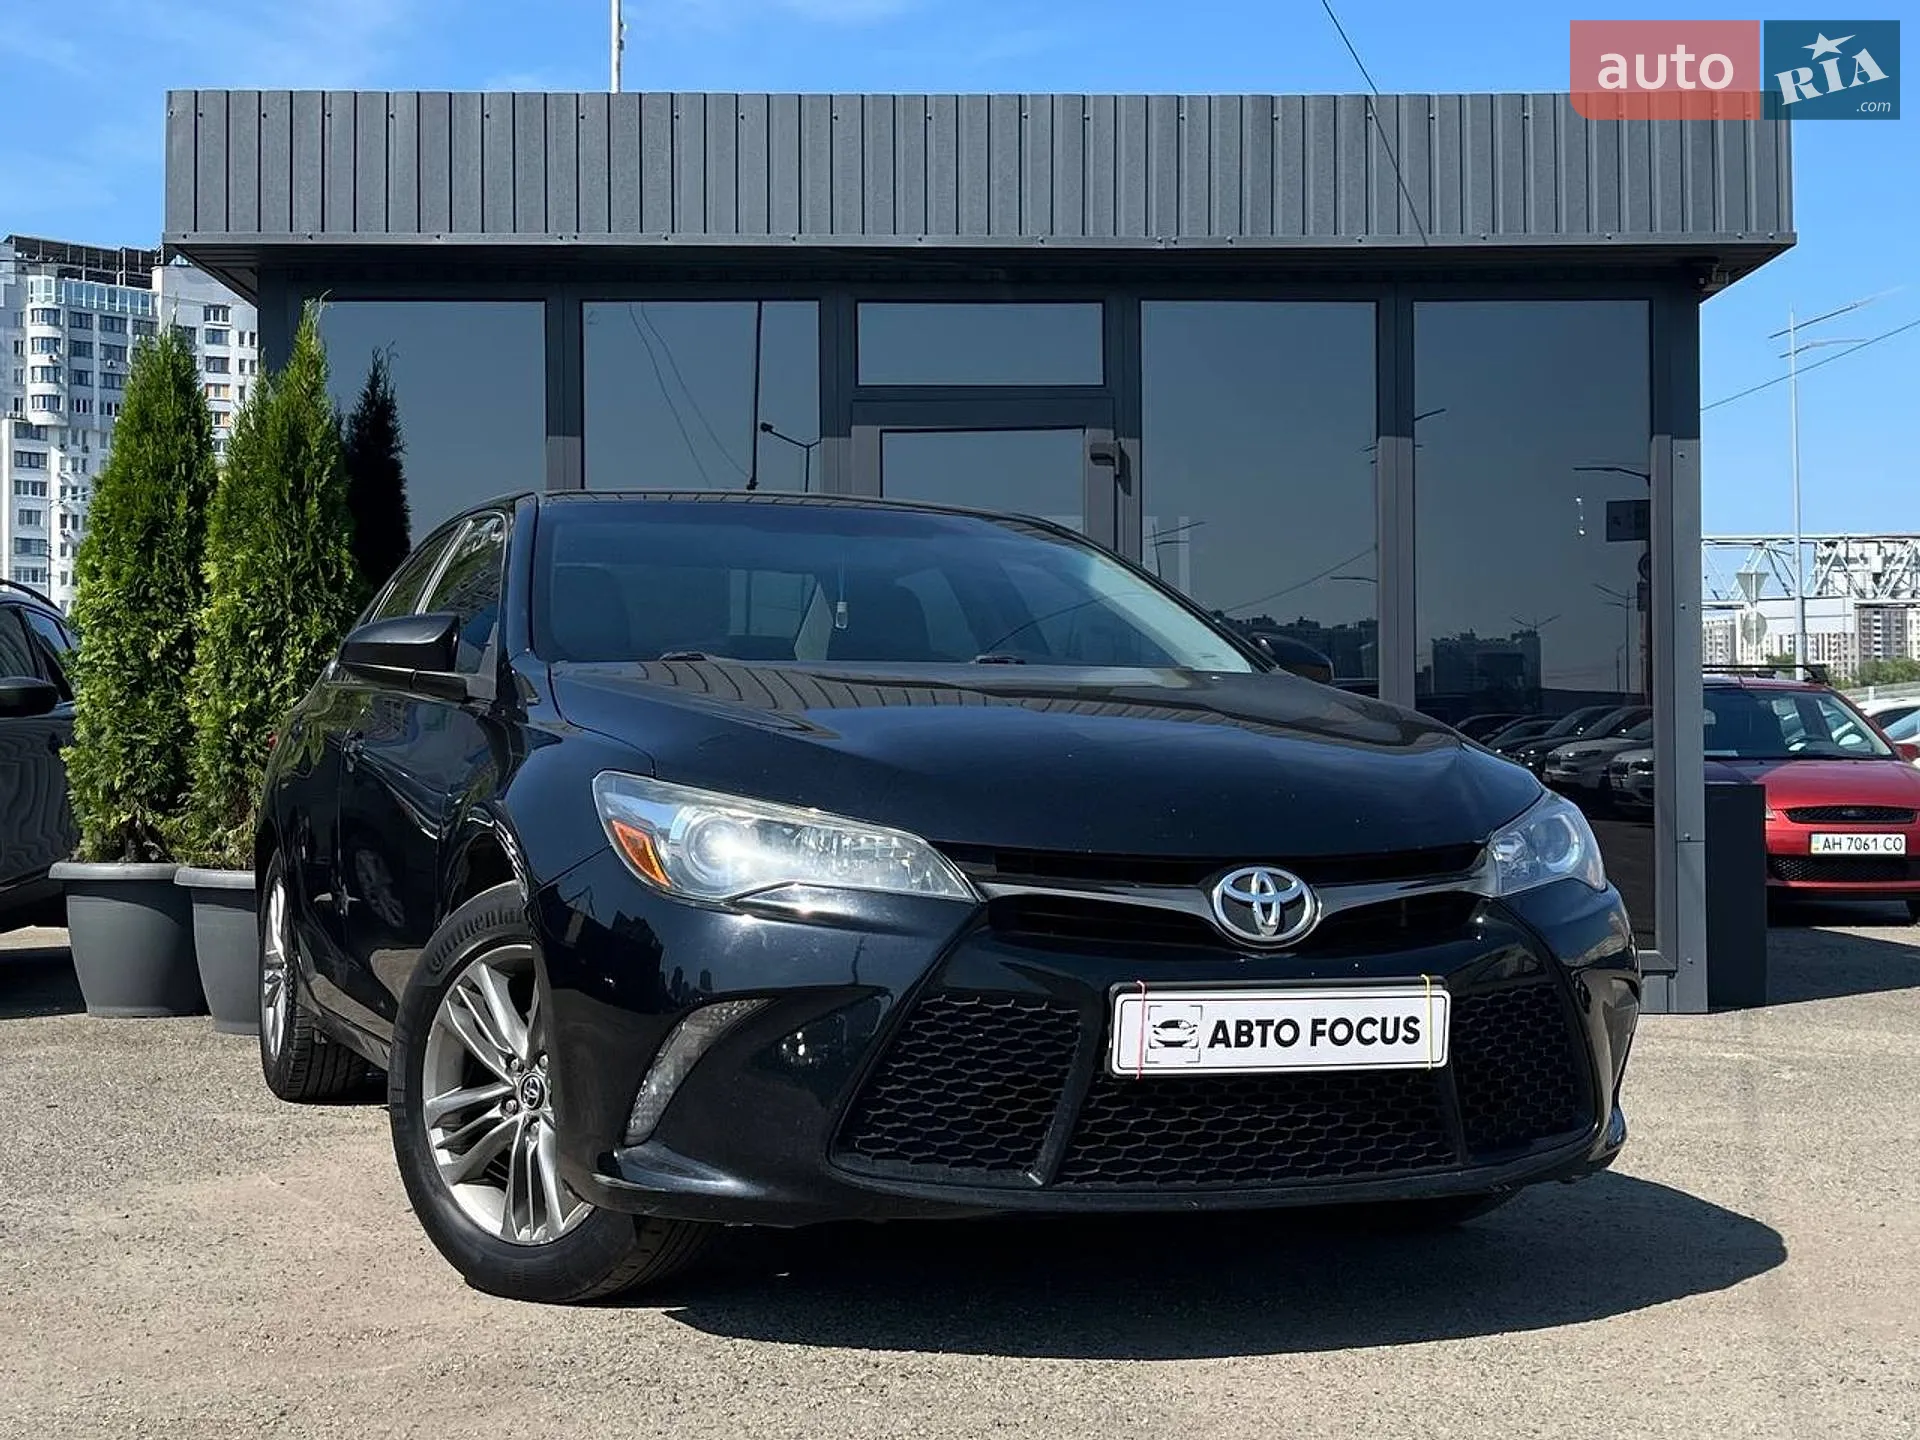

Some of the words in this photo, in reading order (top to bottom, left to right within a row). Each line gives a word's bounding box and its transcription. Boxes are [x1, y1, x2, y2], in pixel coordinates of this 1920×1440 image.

[1822, 837, 1842, 851] AH
[1847, 837, 1878, 851] 7061
[1883, 837, 1903, 851] CO
[1207, 1018, 1301, 1049] АВТО
[1309, 1016, 1421, 1047] FOCUS
